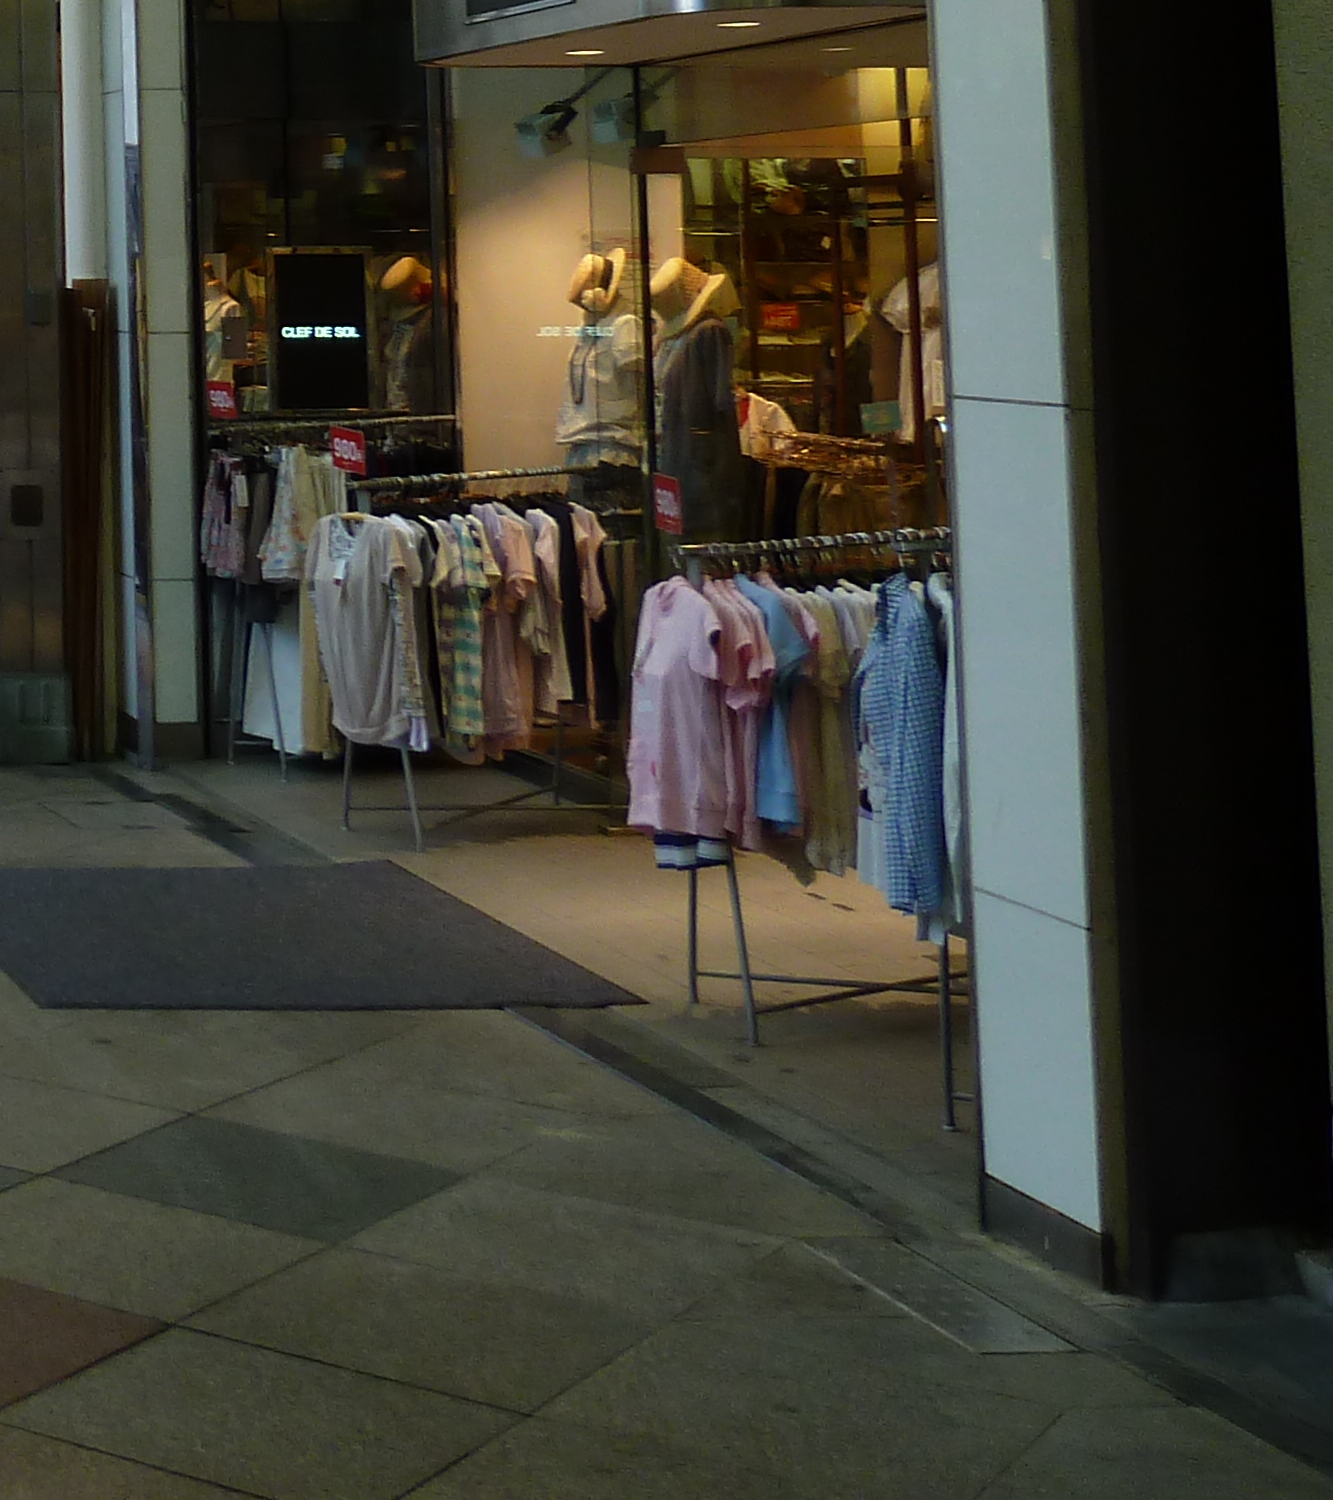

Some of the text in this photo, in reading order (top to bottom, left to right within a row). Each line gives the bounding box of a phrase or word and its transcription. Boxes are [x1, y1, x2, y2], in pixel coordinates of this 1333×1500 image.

[280, 325, 361, 338] CLEF DE SOL
